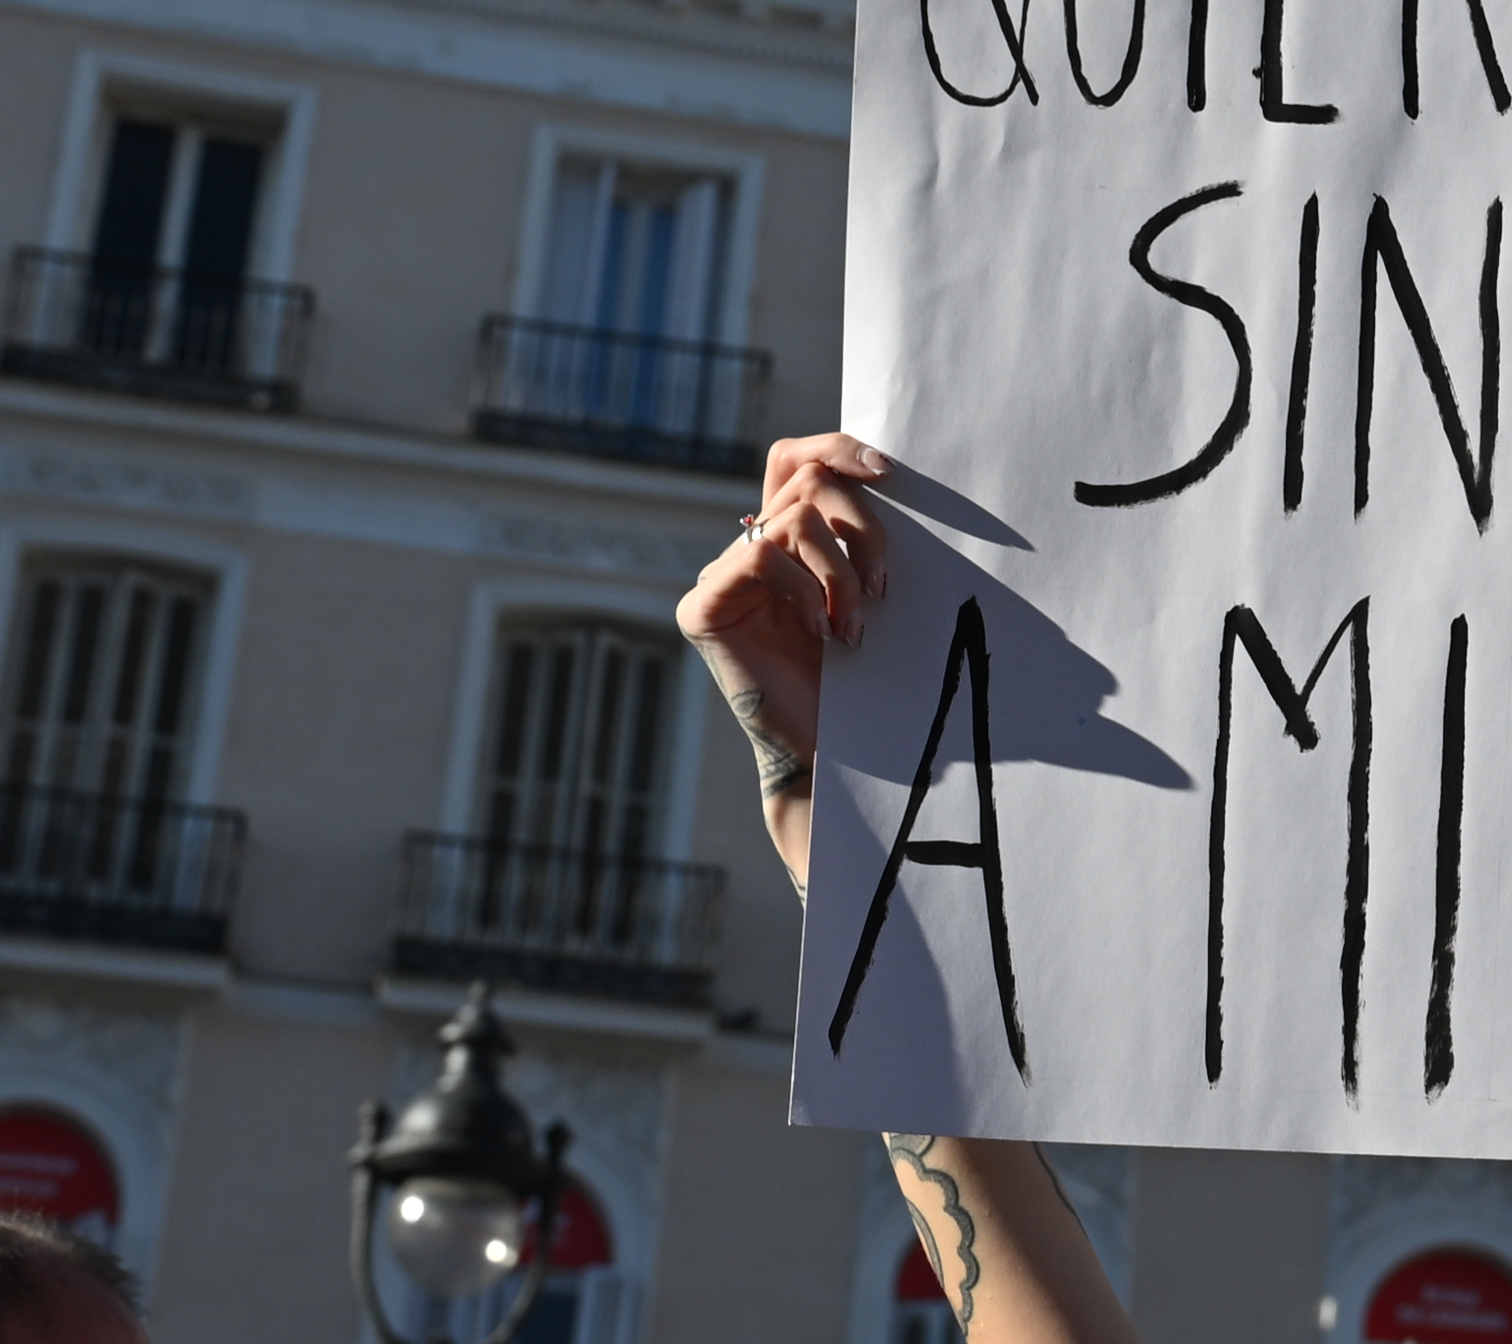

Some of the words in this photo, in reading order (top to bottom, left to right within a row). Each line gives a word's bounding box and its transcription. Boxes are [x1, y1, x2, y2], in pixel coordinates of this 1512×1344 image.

[1071, 178, 1505, 536] SIN
[826, 596, 1033, 1088] A
[1201, 594, 1472, 1106] MI
